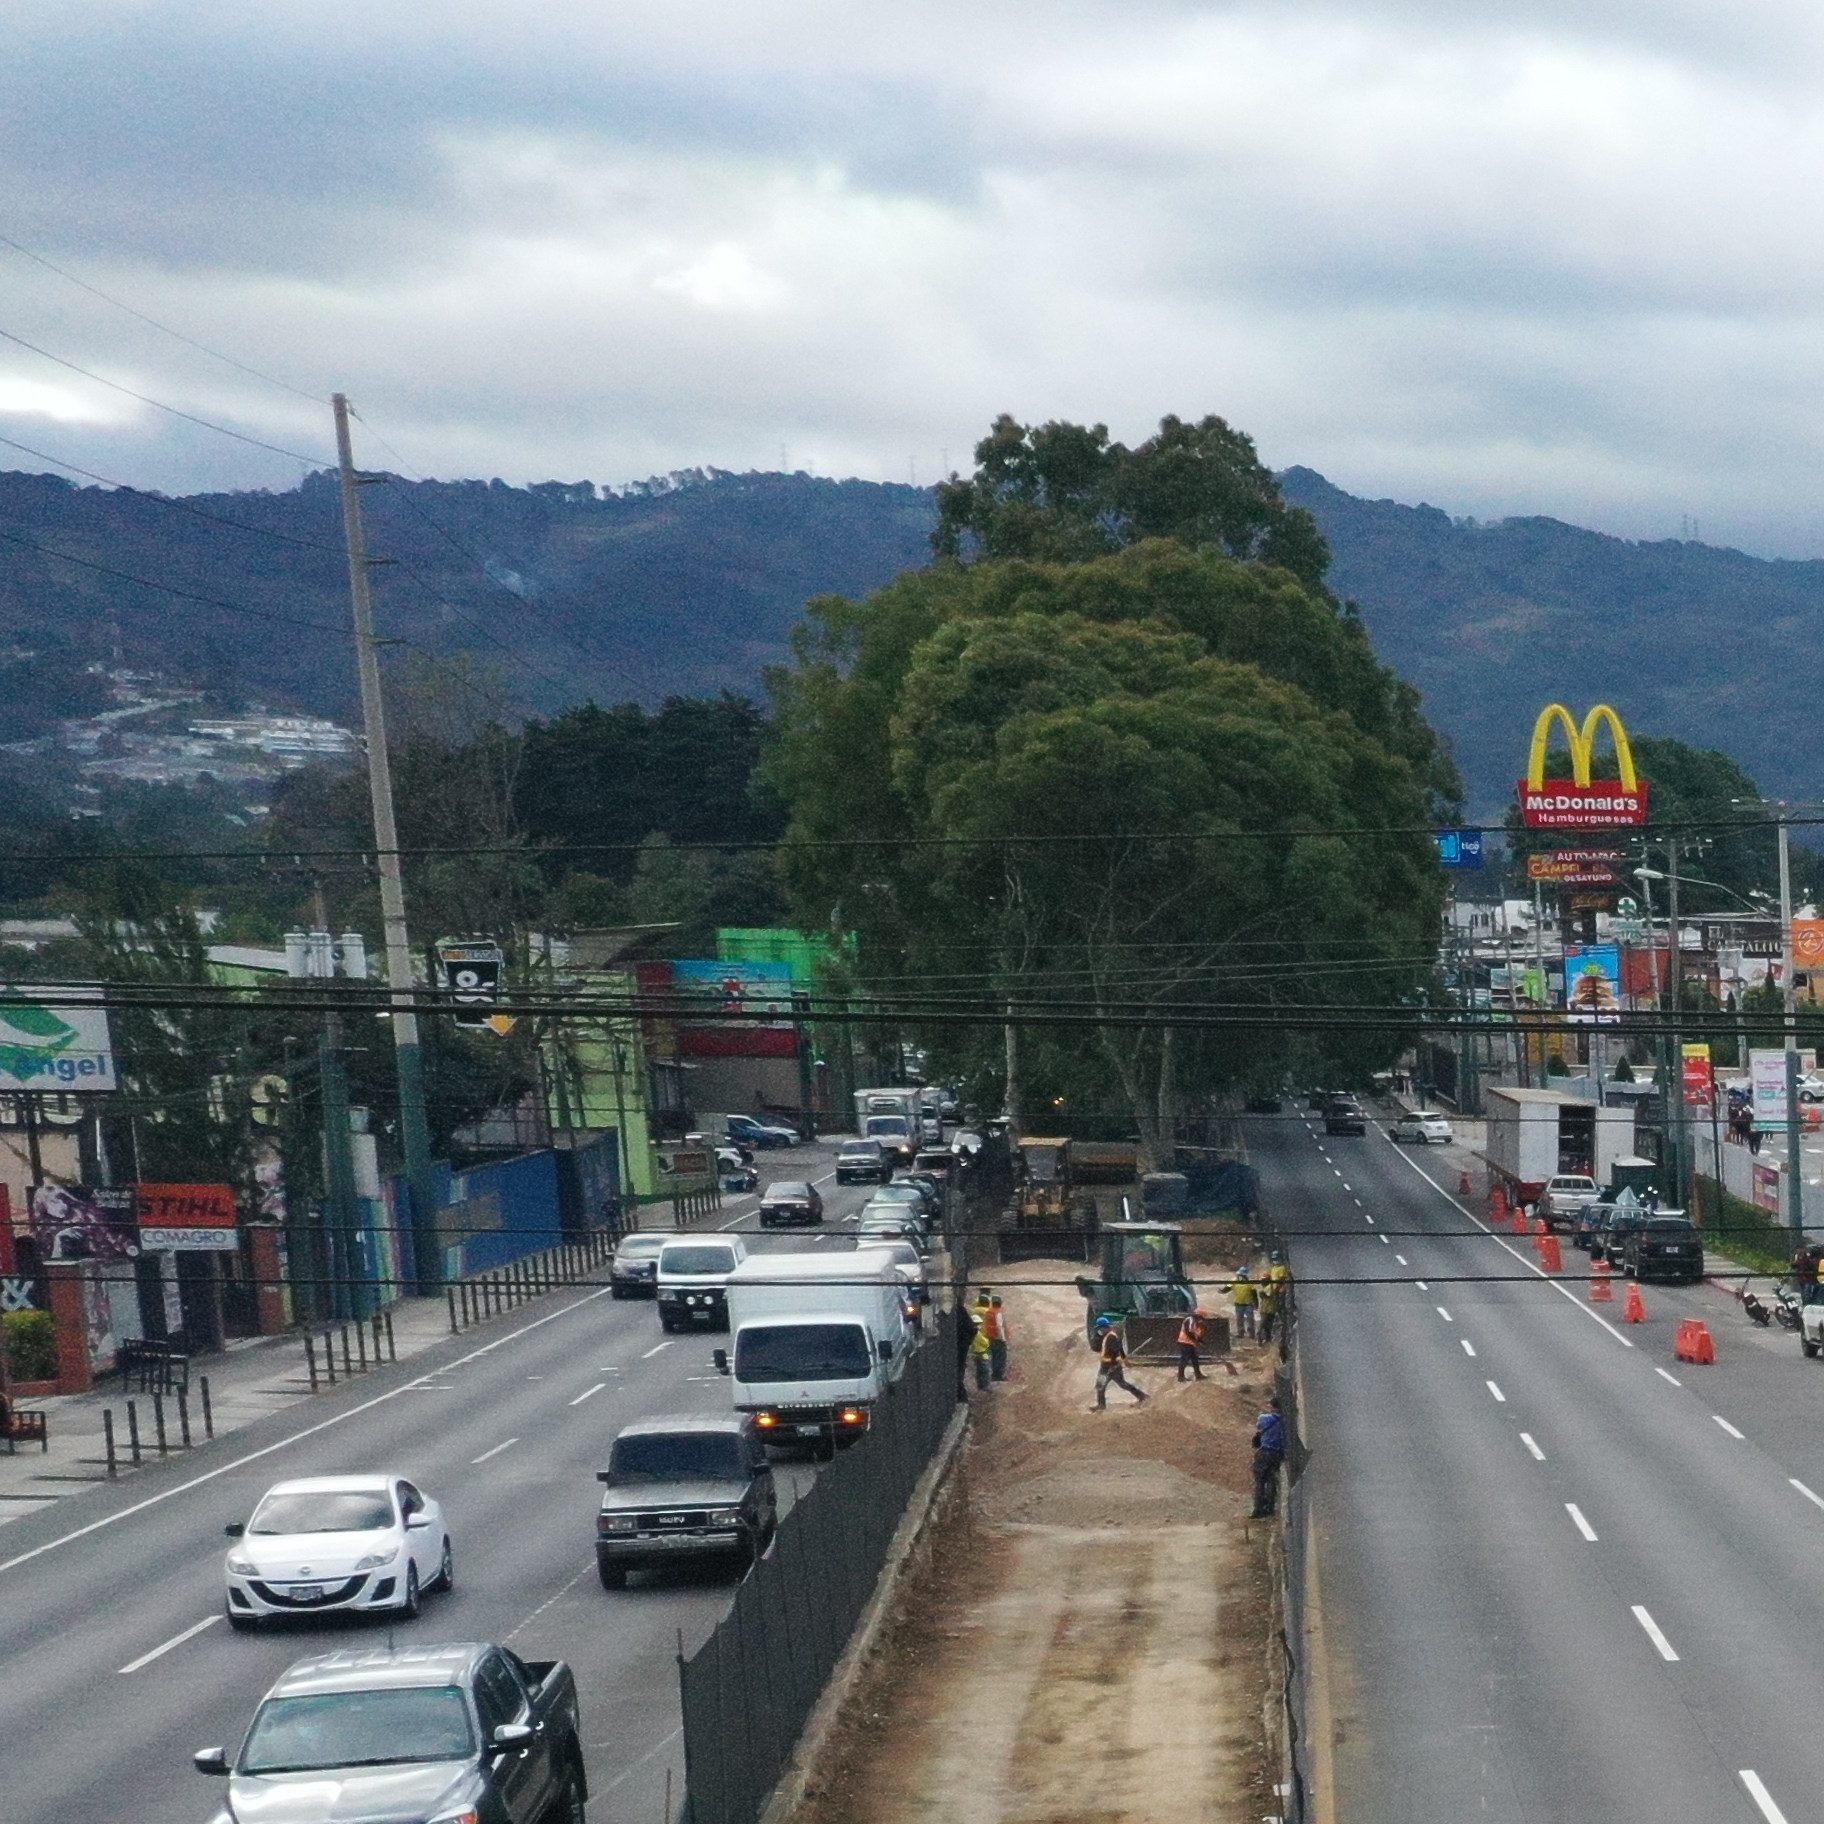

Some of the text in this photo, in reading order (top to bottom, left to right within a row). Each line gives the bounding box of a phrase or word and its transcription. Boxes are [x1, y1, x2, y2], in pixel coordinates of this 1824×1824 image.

[1526, 795, 1639, 812] McDonald's
[1538, 813, 1634, 825] Hamburguesas
[142, 1231, 227, 1247] COMAGRO
